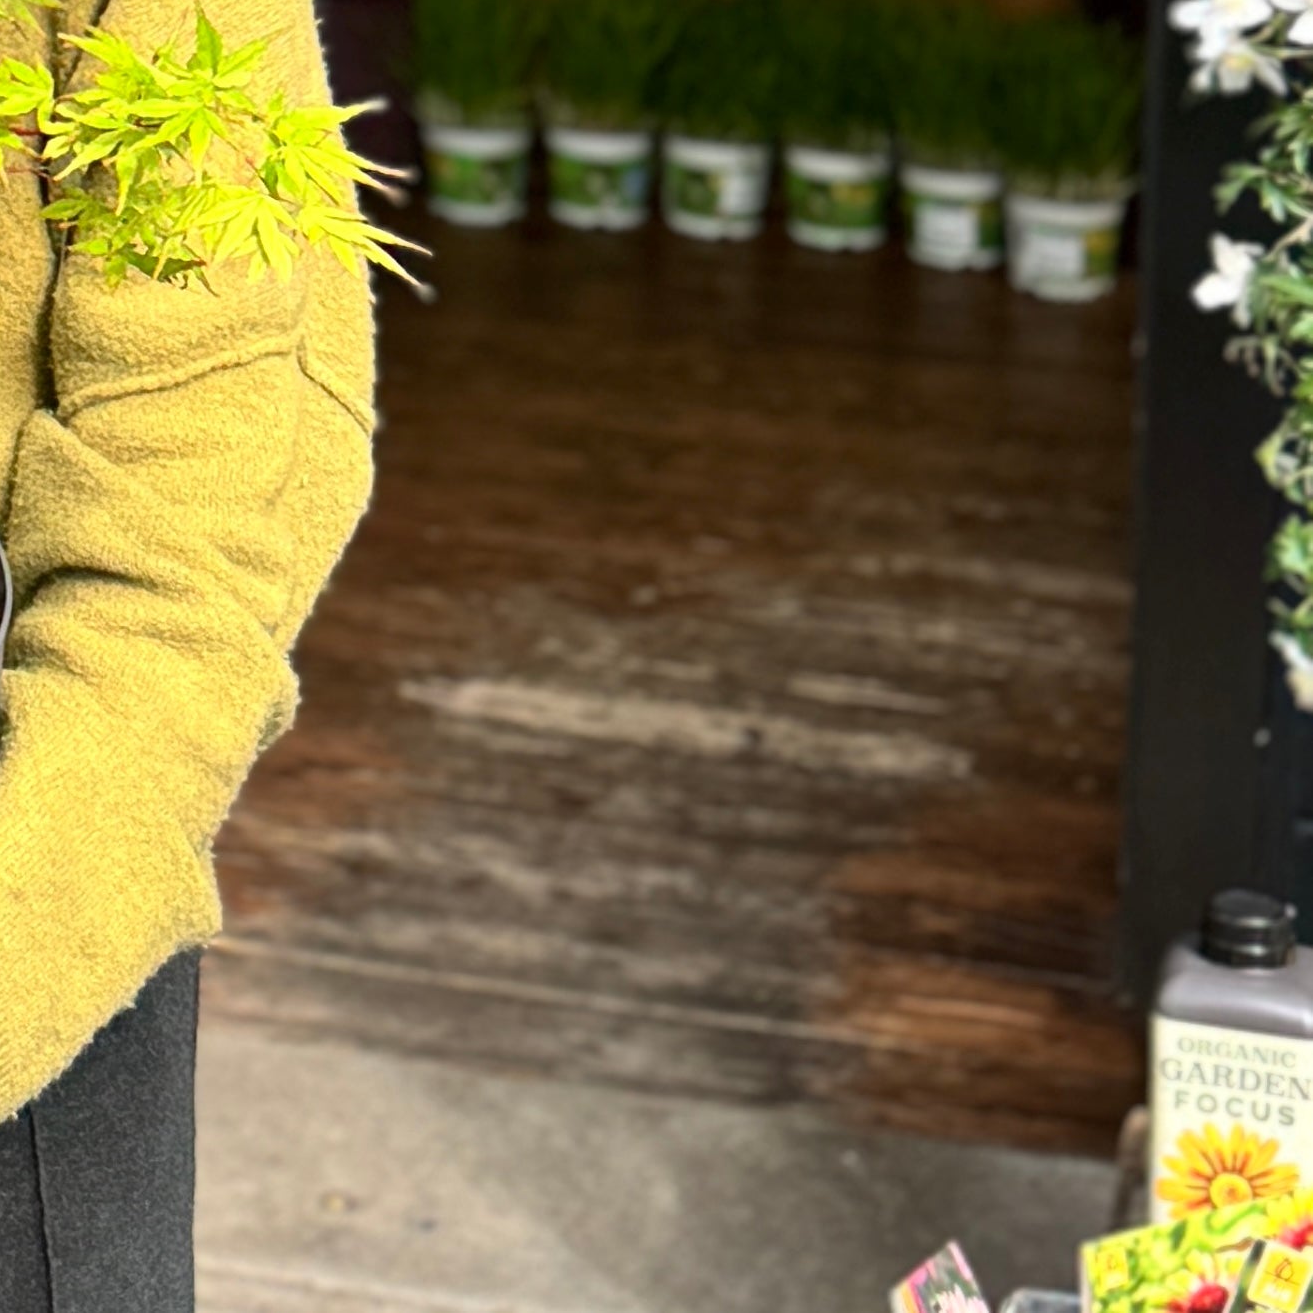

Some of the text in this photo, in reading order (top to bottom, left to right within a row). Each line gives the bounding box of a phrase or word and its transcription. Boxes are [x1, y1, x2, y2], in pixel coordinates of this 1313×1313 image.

[1177, 1037, 1297, 1068] ORGANIC
[1159, 1058, 1313, 1101] GARDEN
[1175, 1089, 1295, 1126] FOCUS
